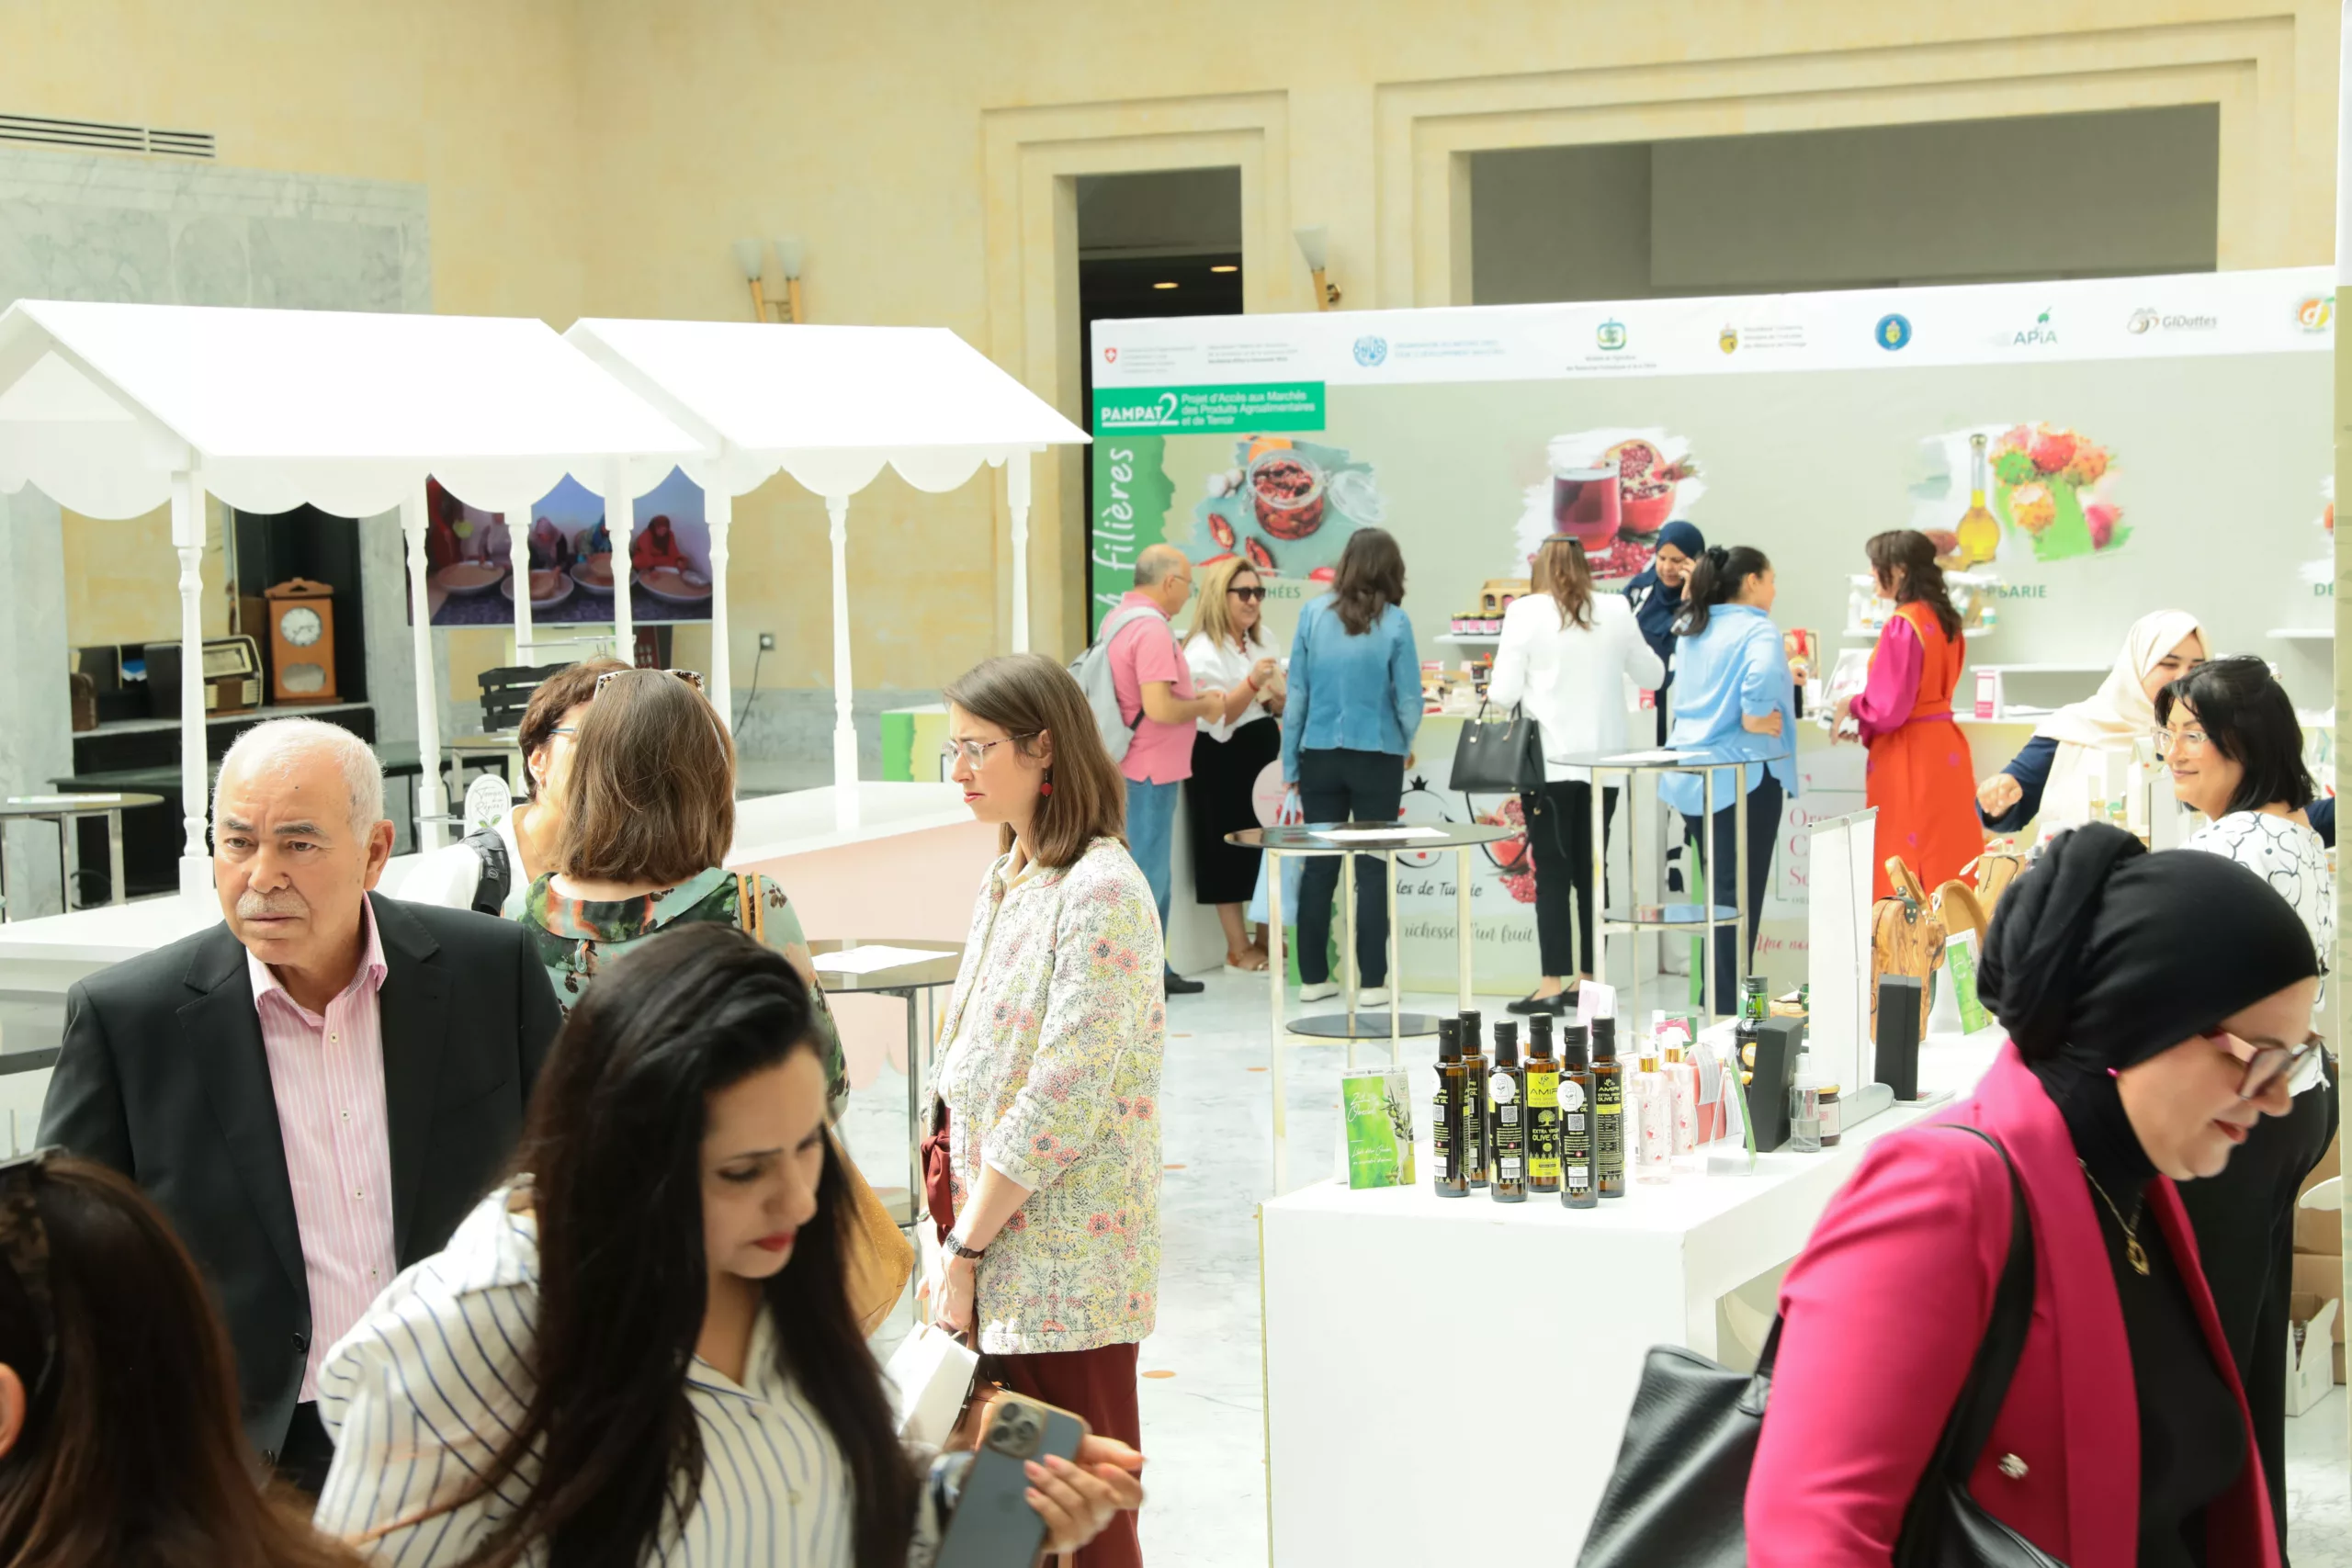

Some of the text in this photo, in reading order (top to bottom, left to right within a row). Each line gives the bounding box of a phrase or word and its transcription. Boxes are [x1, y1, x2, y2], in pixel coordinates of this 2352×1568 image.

[1182, 393, 1208, 404] Projet
[1248, 393, 1265, 402] aux
[1266, 389, 1306, 401] Marchés
[1102, 405, 1164, 422] PAMPAT
[1200, 403, 1238, 414] Produits
[1239, 401, 1316, 415] Agroalimentaires
[1193, 416, 1204, 425] de
[1207, 415, 1235, 425] Terroir
[1092, 447, 1136, 570] filières
[1265, 584, 1301, 599] HÉES
[1418, 879, 1434, 896] de
[1405, 921, 1456, 940] richesse
[1501, 924, 1534, 943] fruit
[1532, 1134, 1551, 1142] OLIVE
